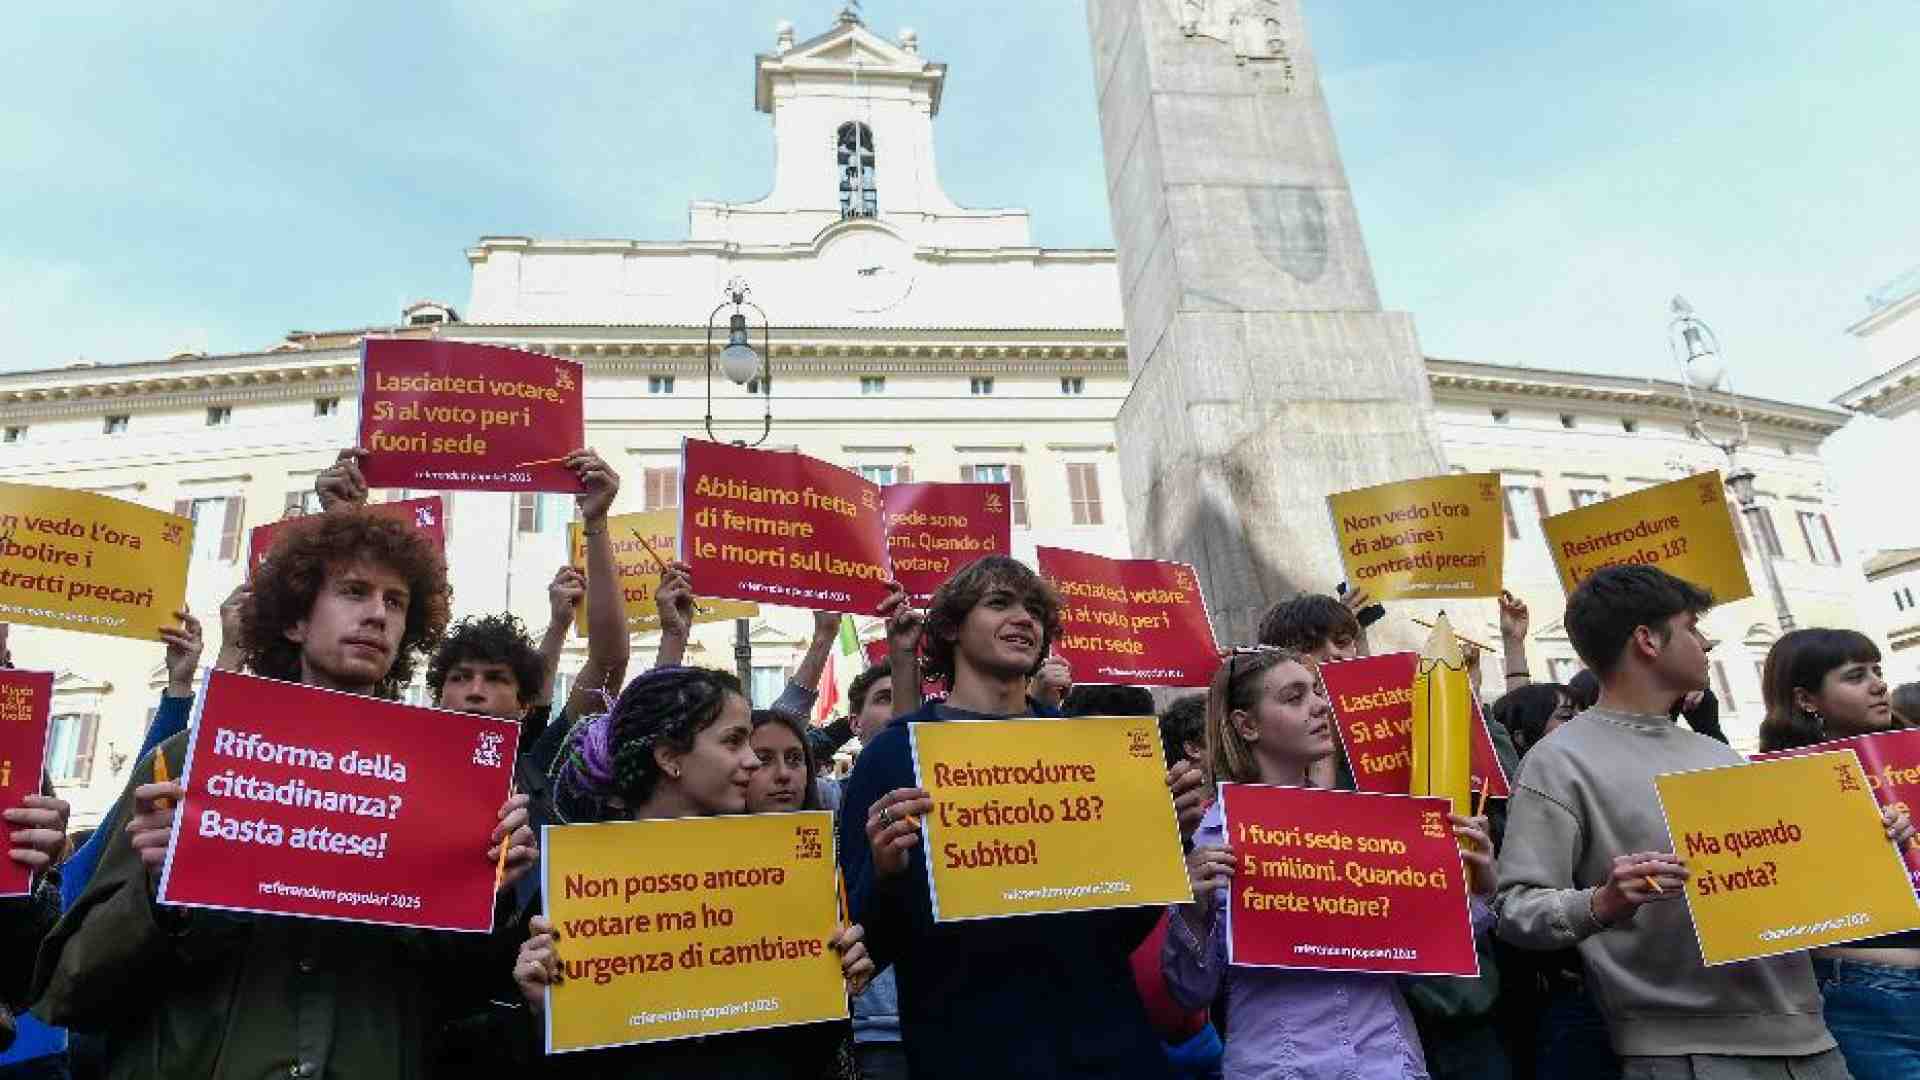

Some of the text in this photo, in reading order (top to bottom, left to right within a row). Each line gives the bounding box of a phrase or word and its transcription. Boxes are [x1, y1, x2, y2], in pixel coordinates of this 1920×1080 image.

[376, 371, 564, 404] Lasciateci votare.
[399, 401, 419, 421] al
[424, 407, 476, 424] voto
[480, 409, 521, 430] per
[522, 406, 531, 427] i
[369, 429, 487, 455] fuori sede
[695, 474, 800, 505] Abbiamo
[803, 487, 857, 517] fretta
[25, 517, 86, 538] vedo
[92, 522, 144, 550] l'ora
[695, 507, 815, 538] di fermare
[889, 510, 968, 528] sede sono
[1342, 501, 1471, 534] Non vedo l'ora
[919, 532, 980, 552] Quando
[983, 534, 996, 550] ci
[1349, 526, 1445, 556] di abolire i
[1561, 512, 1681, 558] Reintrodurre
[1661, 535, 1688, 558] 18?
[0, 541, 94, 569] bolire i
[695, 537, 889, 581] le morti sul lavoro
[893, 556, 951, 573] votare?
[1355, 550, 1487, 580] contratti precari
[0, 567, 154, 608] tratti precari
[1075, 604, 1091, 622] al
[1092, 609, 1129, 628] voto
[1131, 614, 1160, 635] per
[1104, 638, 1145, 655] sede
[1339, 685, 1416, 713] Lasciate
[1373, 718, 1395, 741] al
[213, 727, 407, 783] Riforma della
[1359, 745, 1412, 775] fuori
[933, 759, 1097, 788] Reintrodurre
[207, 769, 403, 820] cittadinanza?
[938, 795, 1105, 829] l'articolo 18?
[199, 810, 389, 859] Basta attese!
[1238, 822, 1407, 856] I fuori sede sono
[1685, 816, 1802, 859] Ma quando
[943, 838, 1039, 869] Subito!
[564, 866, 785, 903] Non posso ancora
[1243, 856, 1448, 890] 5 milioni. Quando ci
[1696, 860, 1779, 897] si vota?
[258, 880, 336, 901] referendum
[390, 893, 422, 909] 2025
[1242, 886, 1391, 918] farete votare?
[563, 902, 734, 939] votare ma ho
[564, 935, 823, 985] urgenza di cambiare
